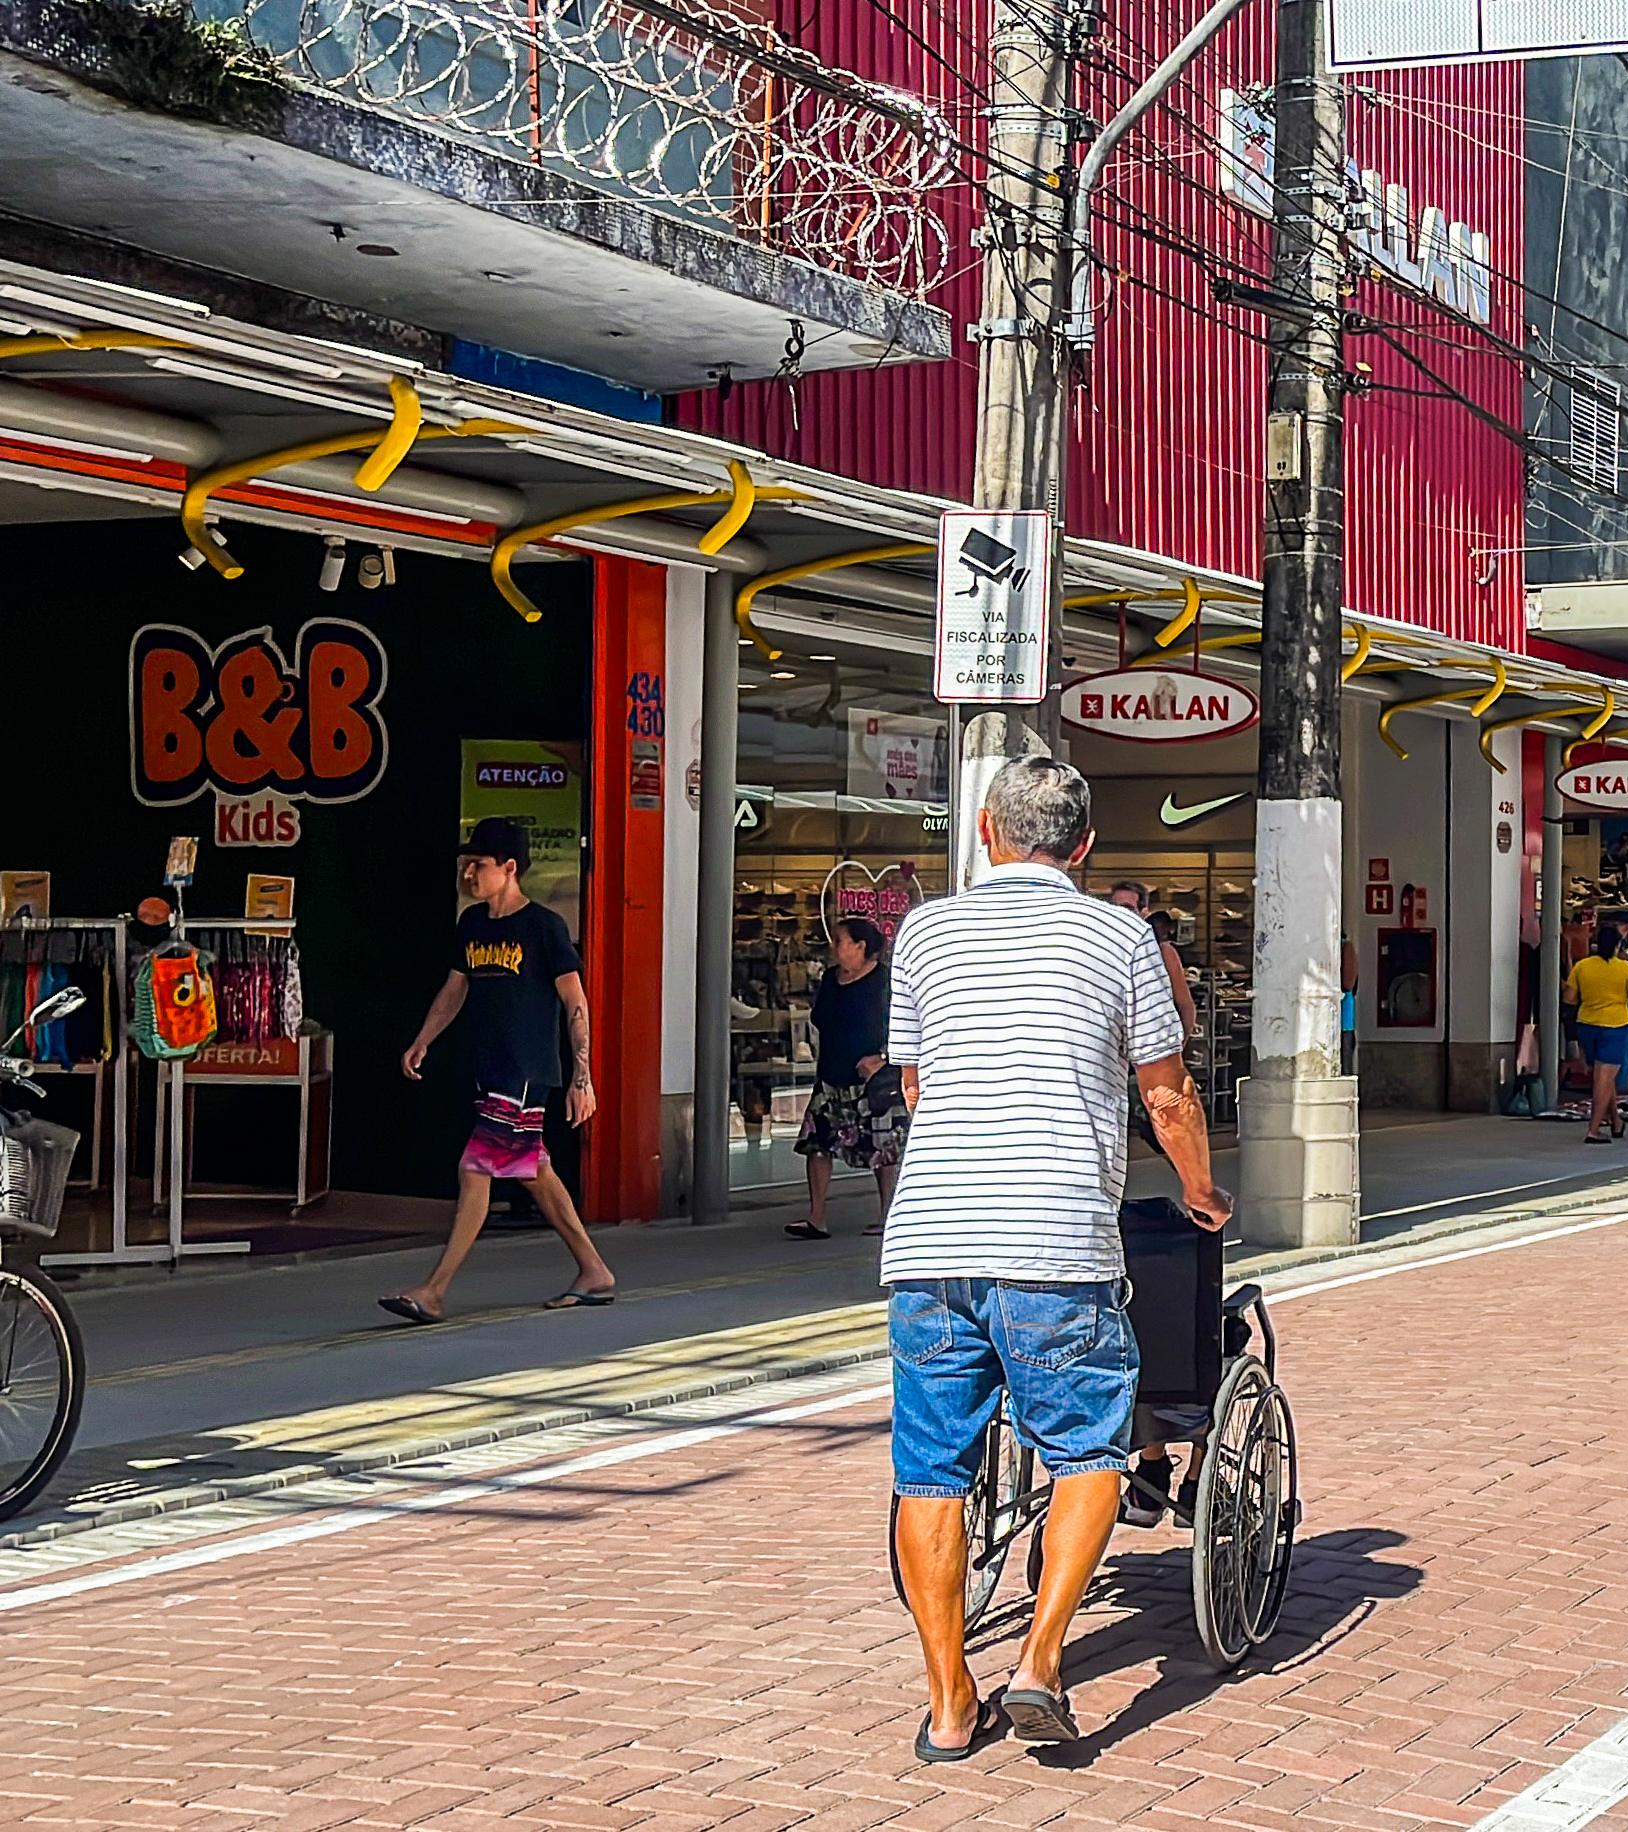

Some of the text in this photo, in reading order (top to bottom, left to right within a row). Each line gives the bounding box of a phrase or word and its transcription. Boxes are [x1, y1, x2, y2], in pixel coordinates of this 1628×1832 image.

[1346, 157, 1490, 324] LLAN
[982, 611, 1005, 623] VIA
[947, 631, 1038, 645] FISCALIZADA
[976, 654, 1006, 667] POR
[956, 669, 1025, 685] CÂMERAS
[627, 672, 662, 706] 434
[138, 636, 376, 790] B&B
[1111, 693, 1230, 721] KALLAN
[627, 704, 665, 737] 430
[478, 765, 565, 786] ATENÇÃO
[1498, 801, 1515, 815] 426
[217, 800, 296, 843] Kids
[1372, 889, 1388, 910] H
